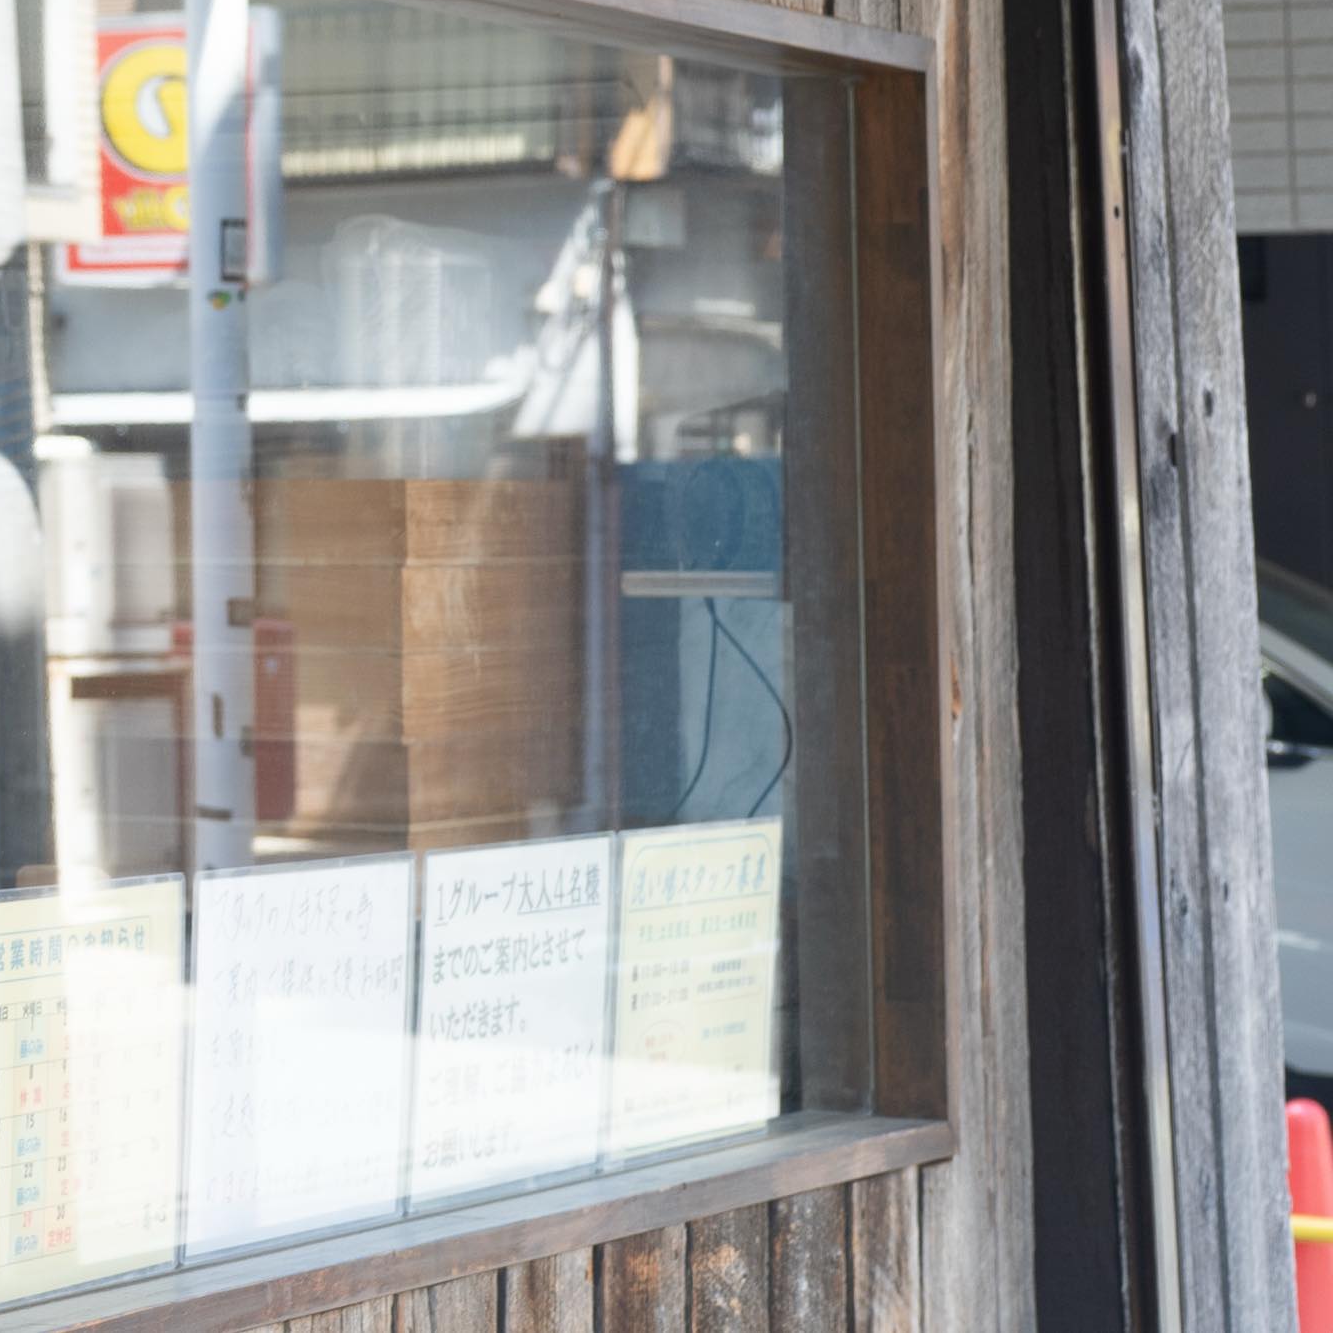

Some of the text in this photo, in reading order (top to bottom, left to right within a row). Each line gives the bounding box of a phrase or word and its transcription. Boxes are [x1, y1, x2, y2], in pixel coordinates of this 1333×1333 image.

[434, 863, 601, 924] 1グループ大人4名様
[431, 927, 588, 987] までのご案内とさせて
[428, 995, 527, 1044] いただきます。
